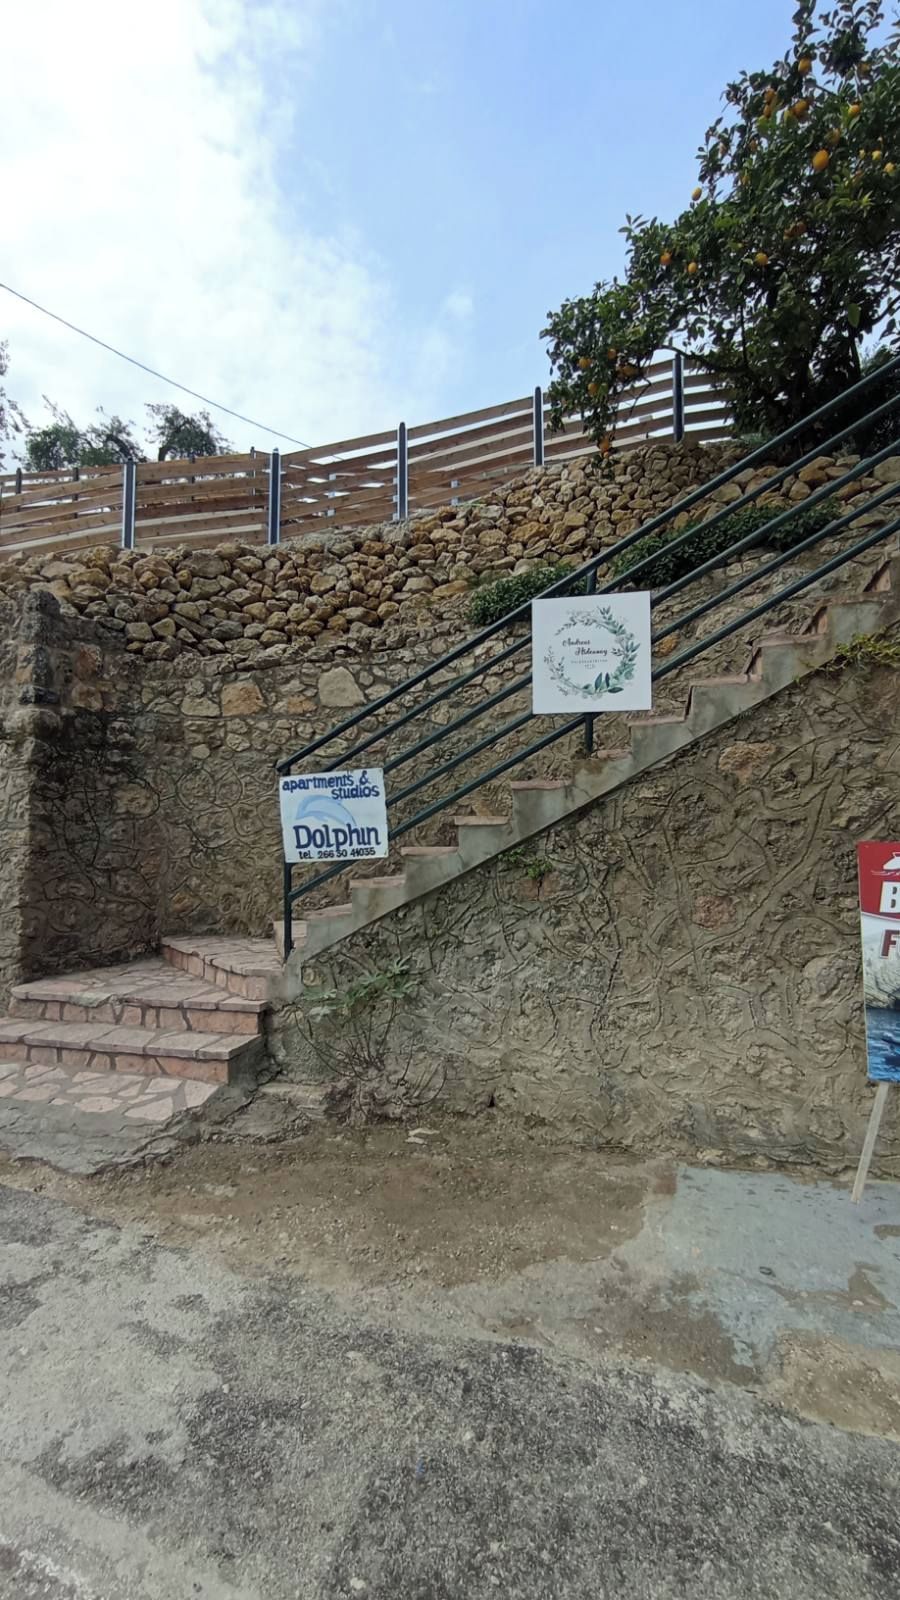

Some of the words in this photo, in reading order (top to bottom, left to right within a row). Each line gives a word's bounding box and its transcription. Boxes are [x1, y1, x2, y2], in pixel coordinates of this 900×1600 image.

[282, 774, 355, 793] apartments
[359, 770, 371, 786] &
[331, 785, 380, 800] studios
[293, 823, 381, 852] Dolphin
